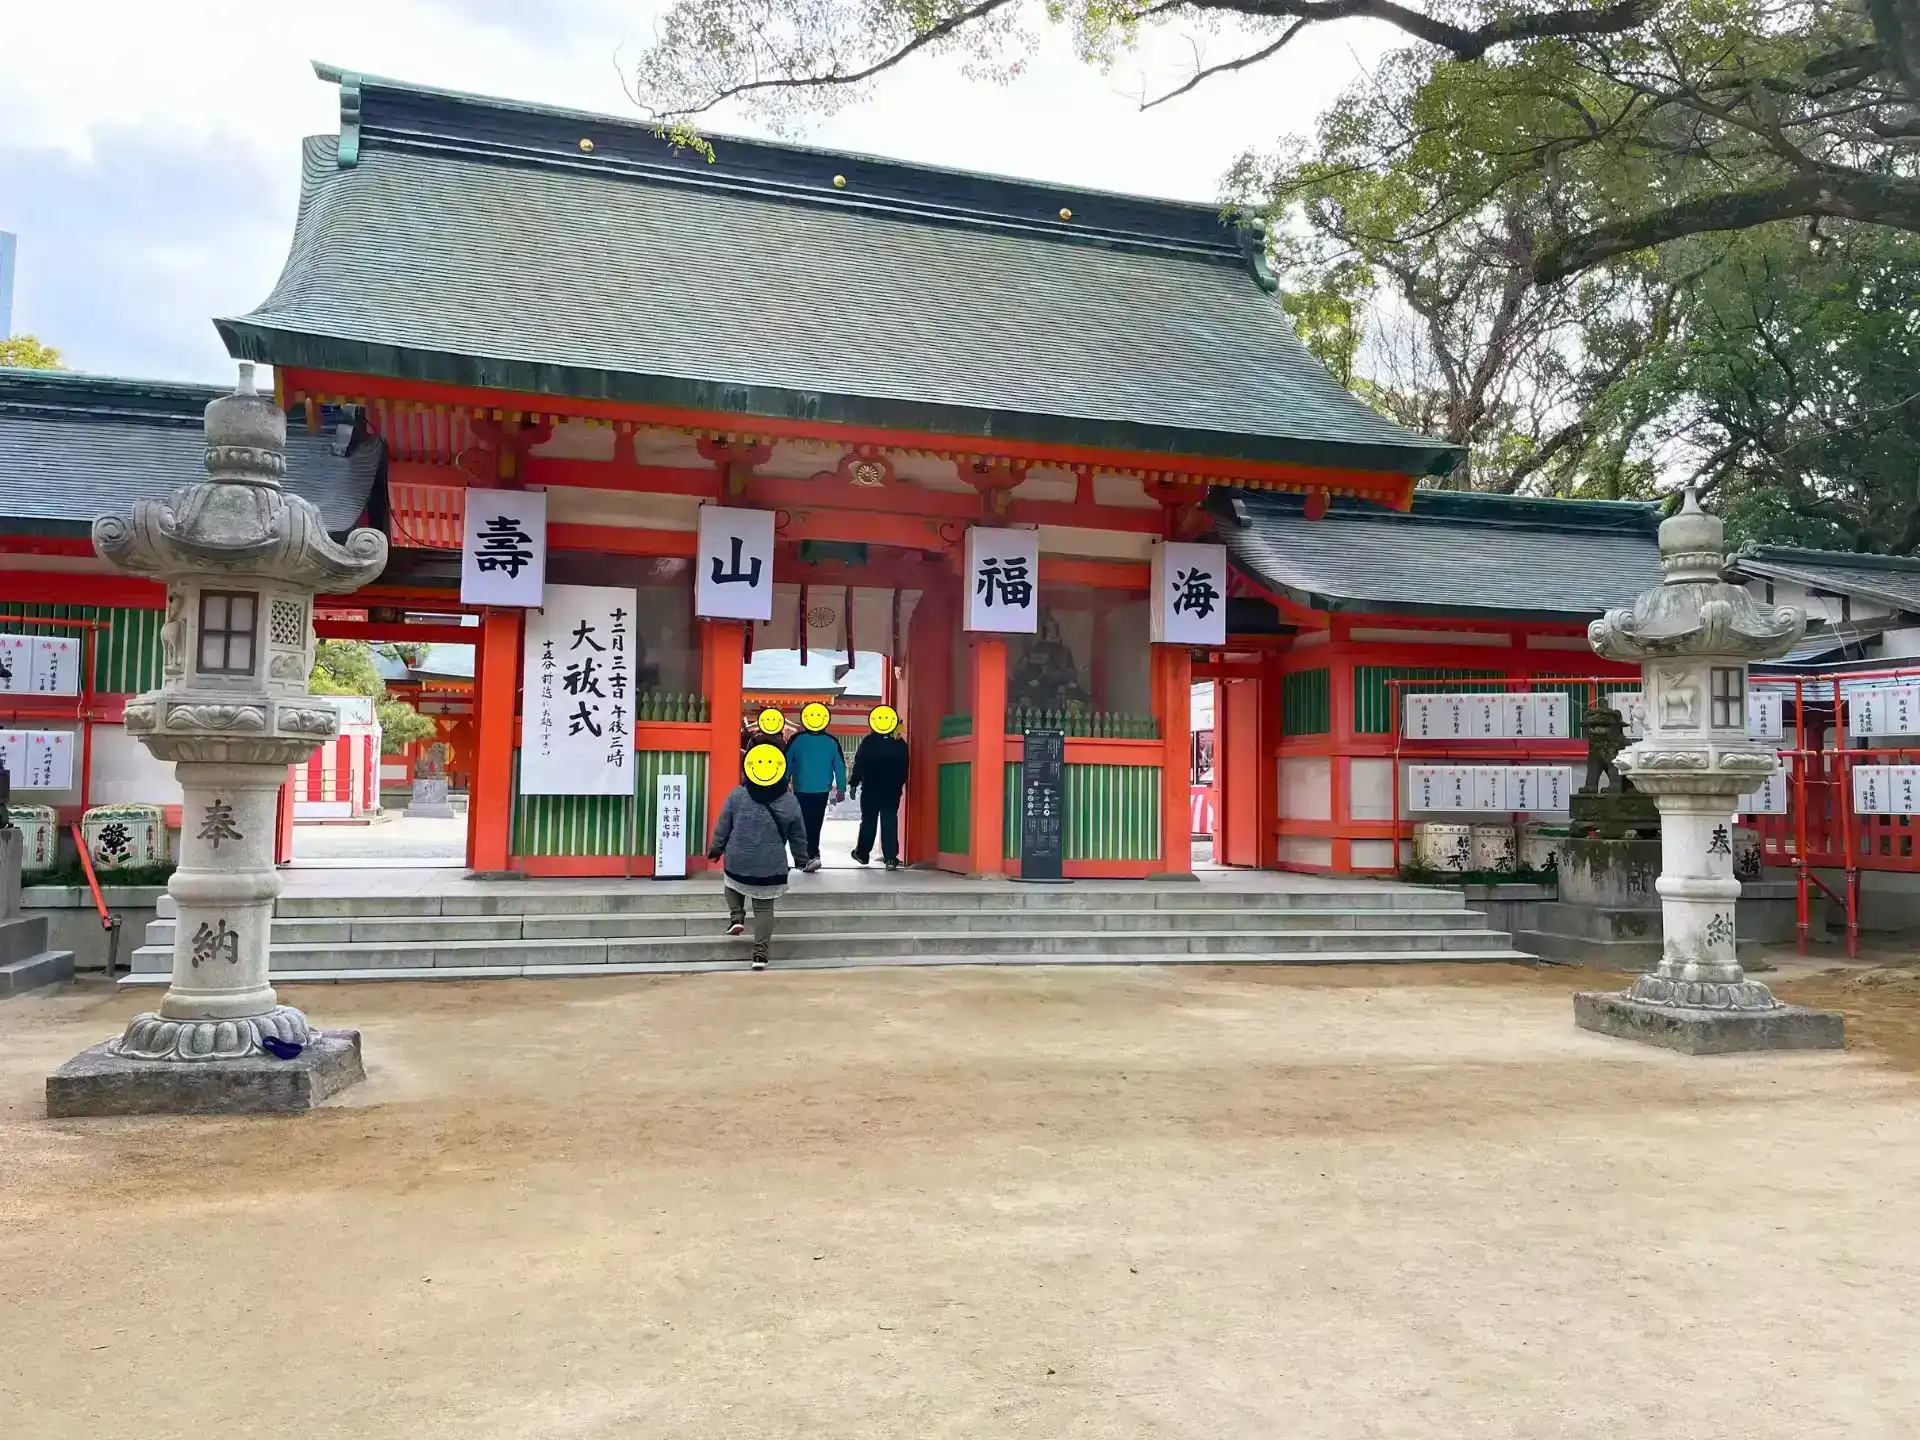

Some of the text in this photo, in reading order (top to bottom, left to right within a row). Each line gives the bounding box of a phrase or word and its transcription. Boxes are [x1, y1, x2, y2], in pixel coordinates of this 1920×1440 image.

[474, 516, 534, 579] 壽
[711, 536, 763, 588] 山
[977, 557, 1033, 609] 福
[1171, 566, 1220, 619] 海
[562, 620, 607, 738] 大祓式
